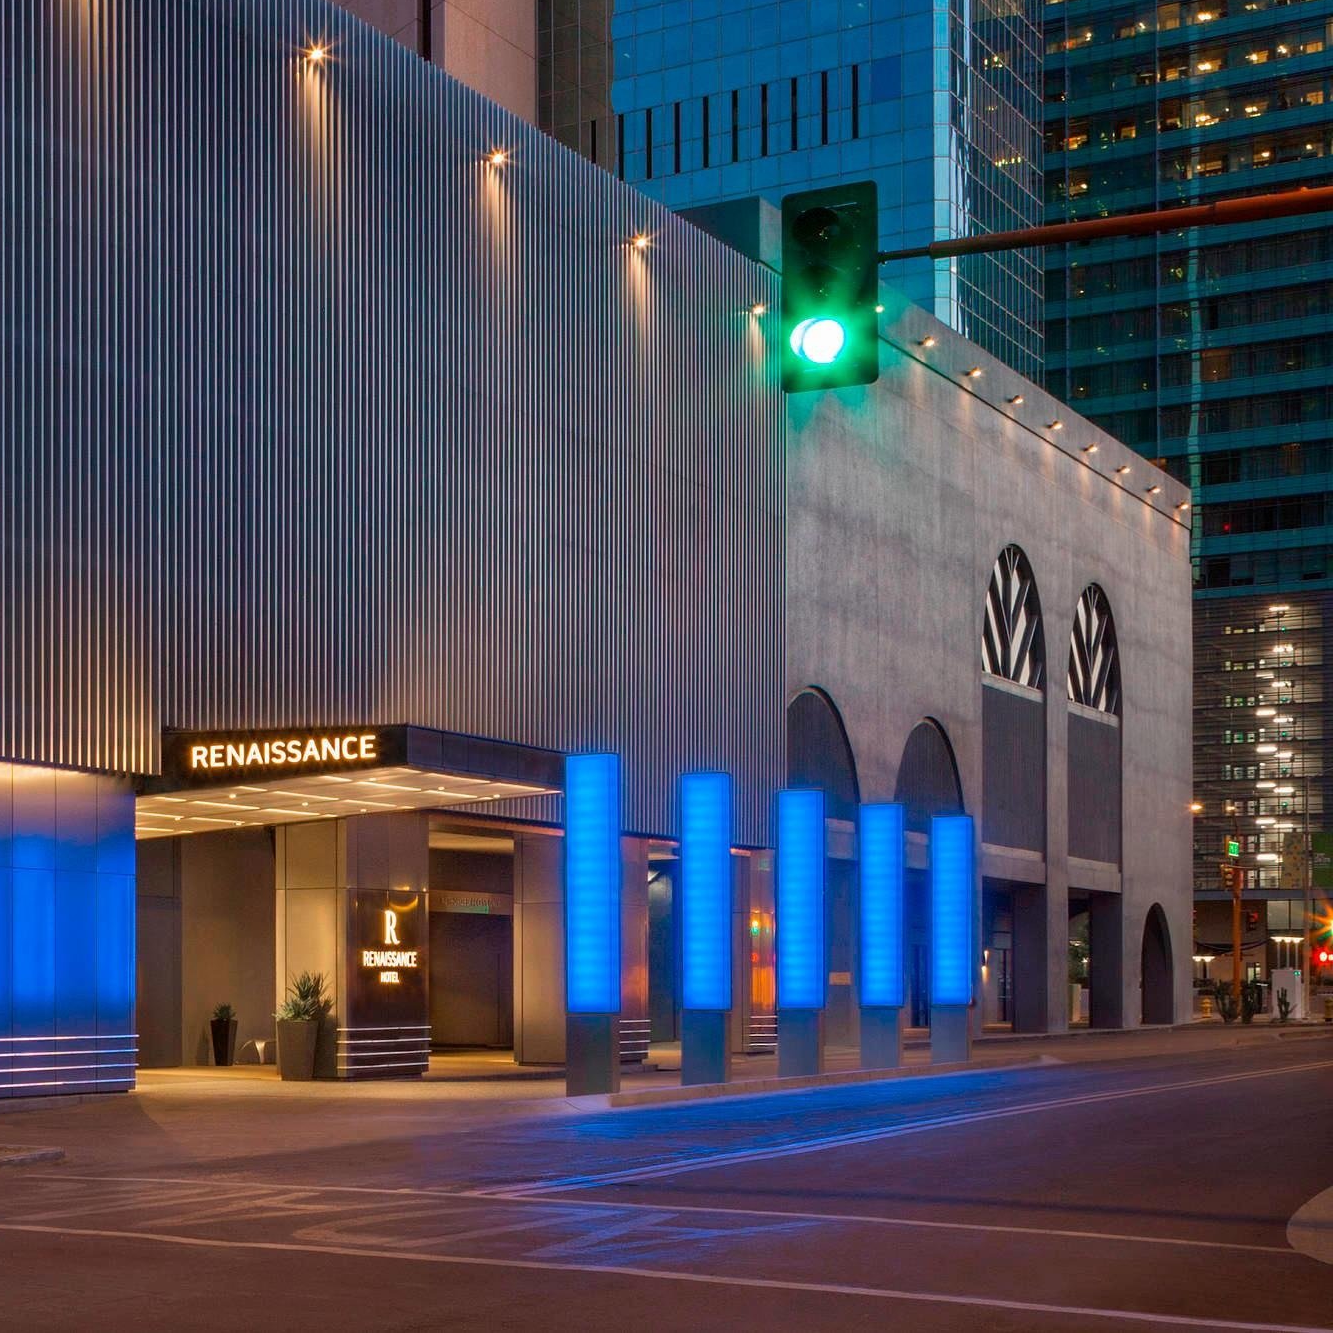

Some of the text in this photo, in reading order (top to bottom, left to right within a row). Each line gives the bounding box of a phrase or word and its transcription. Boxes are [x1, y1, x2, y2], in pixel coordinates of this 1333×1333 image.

[191, 734, 377, 769] RENAISSANCE
[384, 909, 400, 945] R
[363, 951, 418, 967] RENAISSANCE
[380, 971, 400, 983] HOTEL
